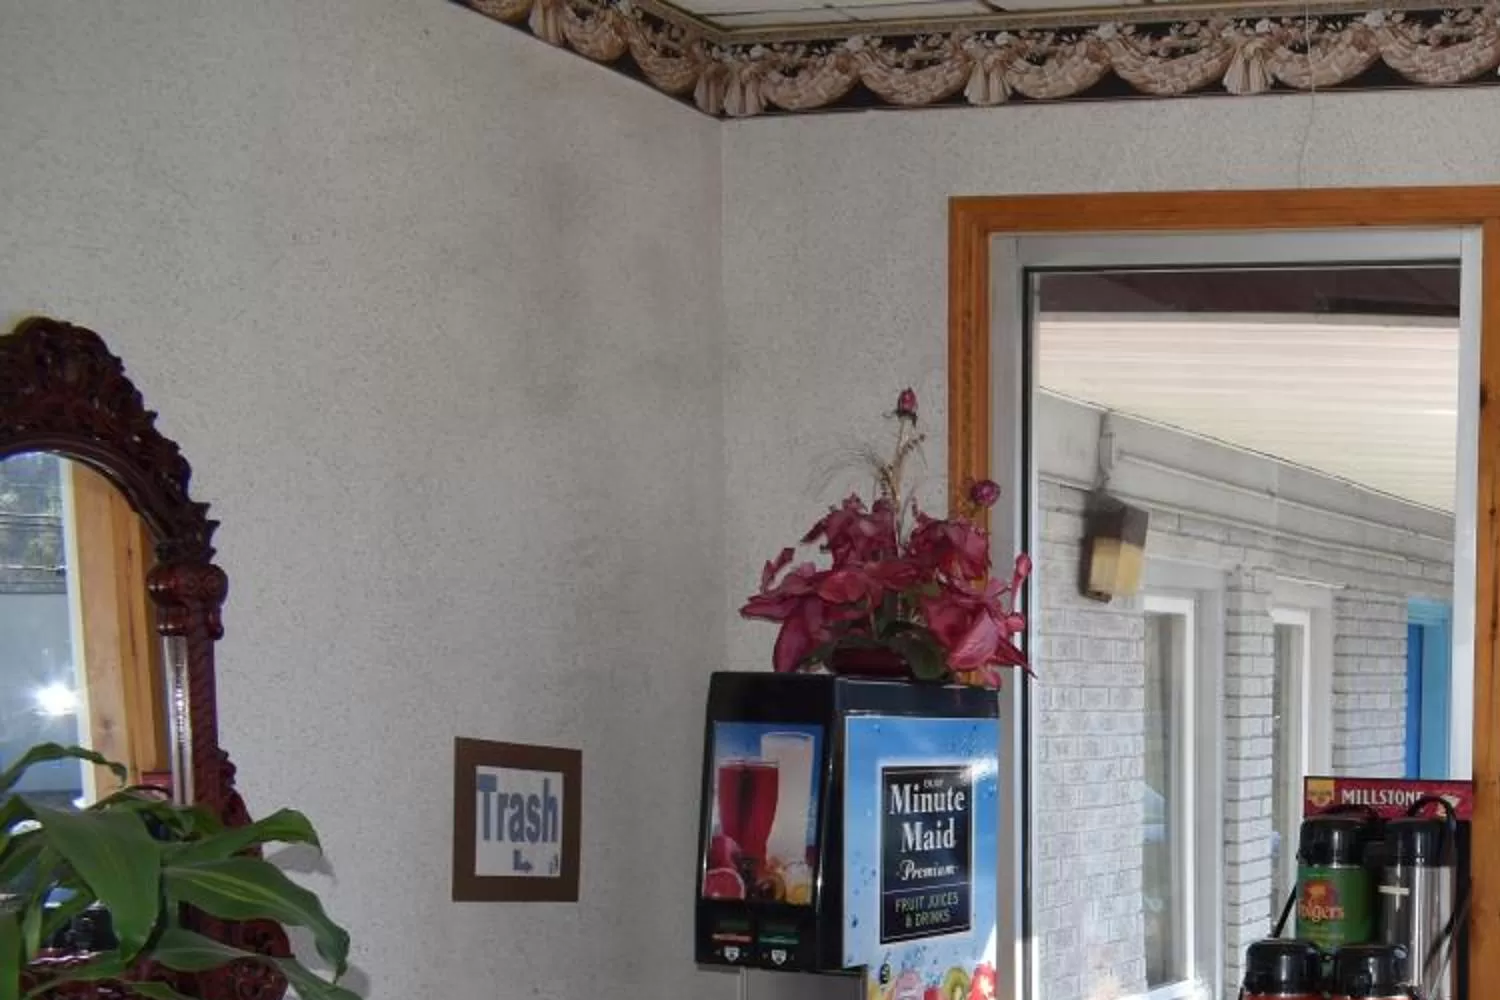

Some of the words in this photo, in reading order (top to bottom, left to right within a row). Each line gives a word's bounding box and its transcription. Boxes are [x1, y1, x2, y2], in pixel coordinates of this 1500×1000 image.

[477, 774, 559, 843] Trash
[889, 782, 966, 816] Minute
[901, 817, 957, 853] Maid
[900, 859, 957, 882] Premium
[895, 895, 925, 914] FRUIT
